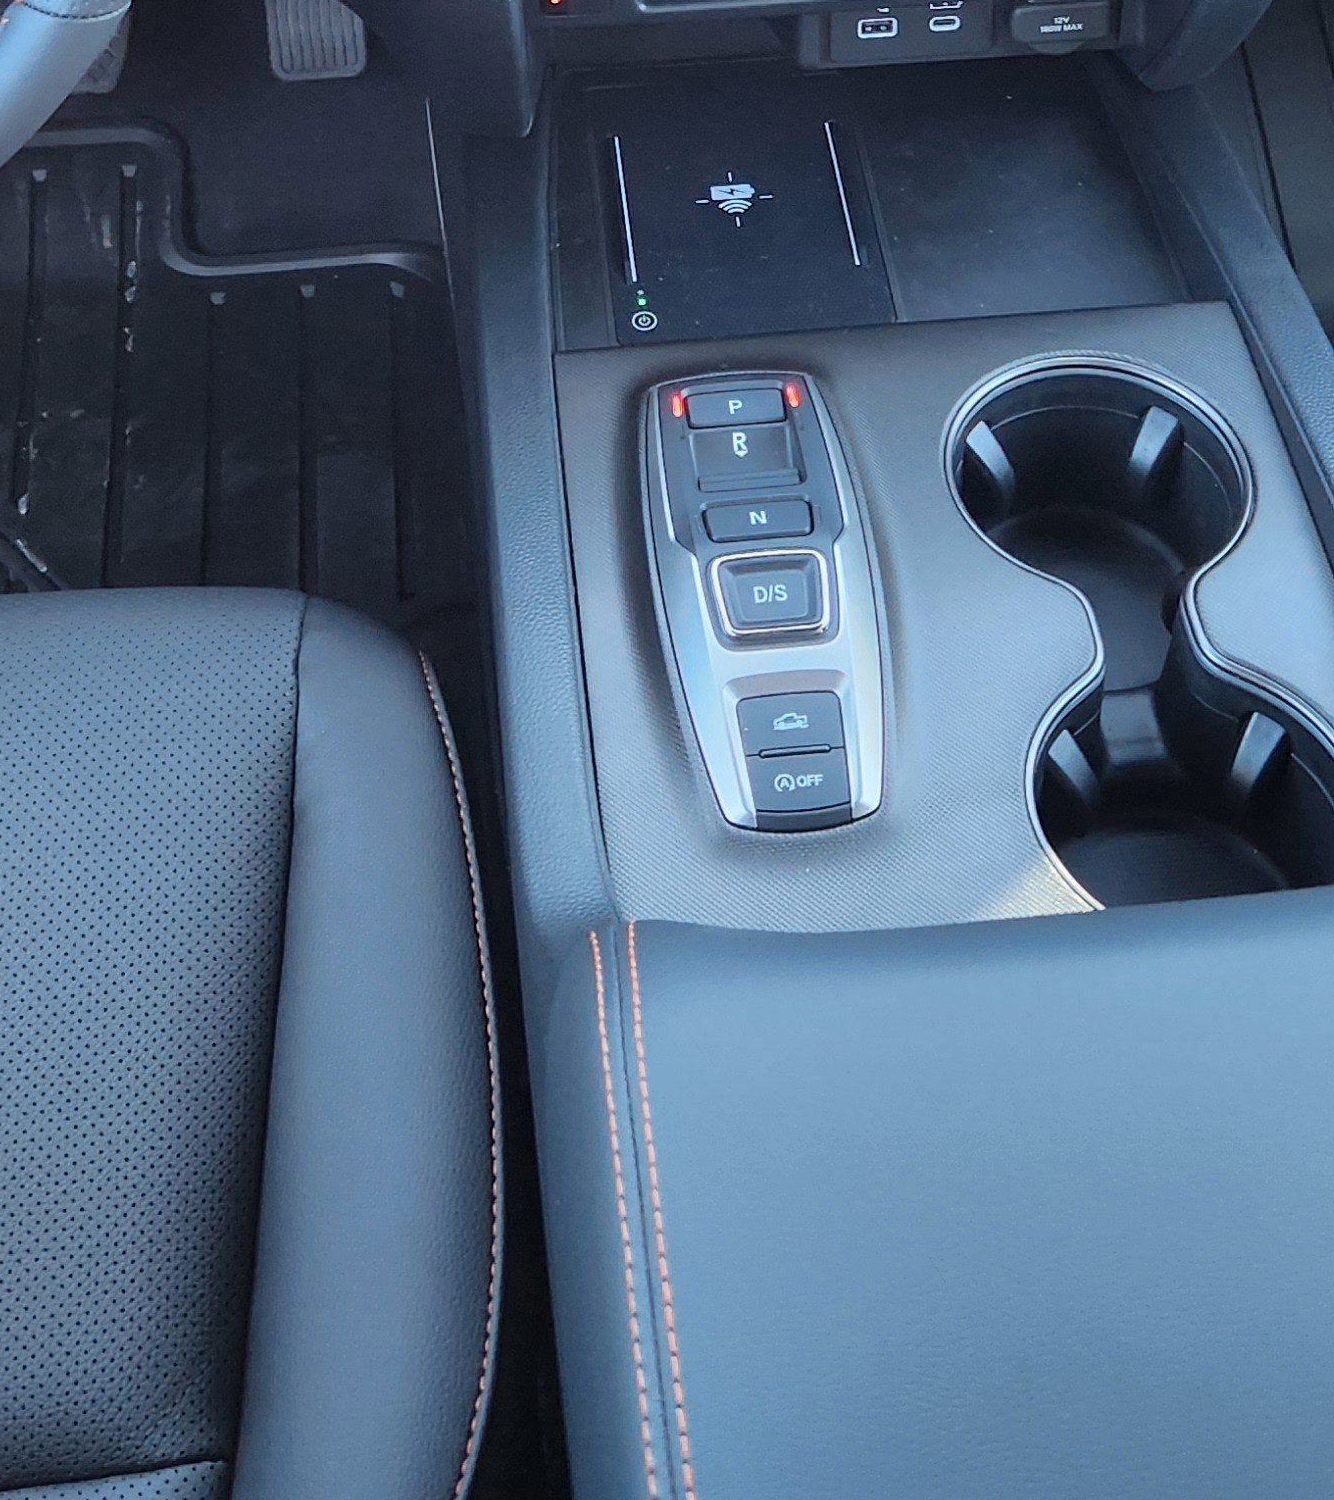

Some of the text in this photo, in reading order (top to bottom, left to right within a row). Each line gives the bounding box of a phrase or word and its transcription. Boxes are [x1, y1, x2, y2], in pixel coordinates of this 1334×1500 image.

[1063, 23, 1084, 31] MAX
[728, 399, 743, 415] P
[731, 431, 747, 450] R
[750, 510, 768, 526] N
[753, 584, 788, 604] D/S
[796, 774, 824, 788] OFF
